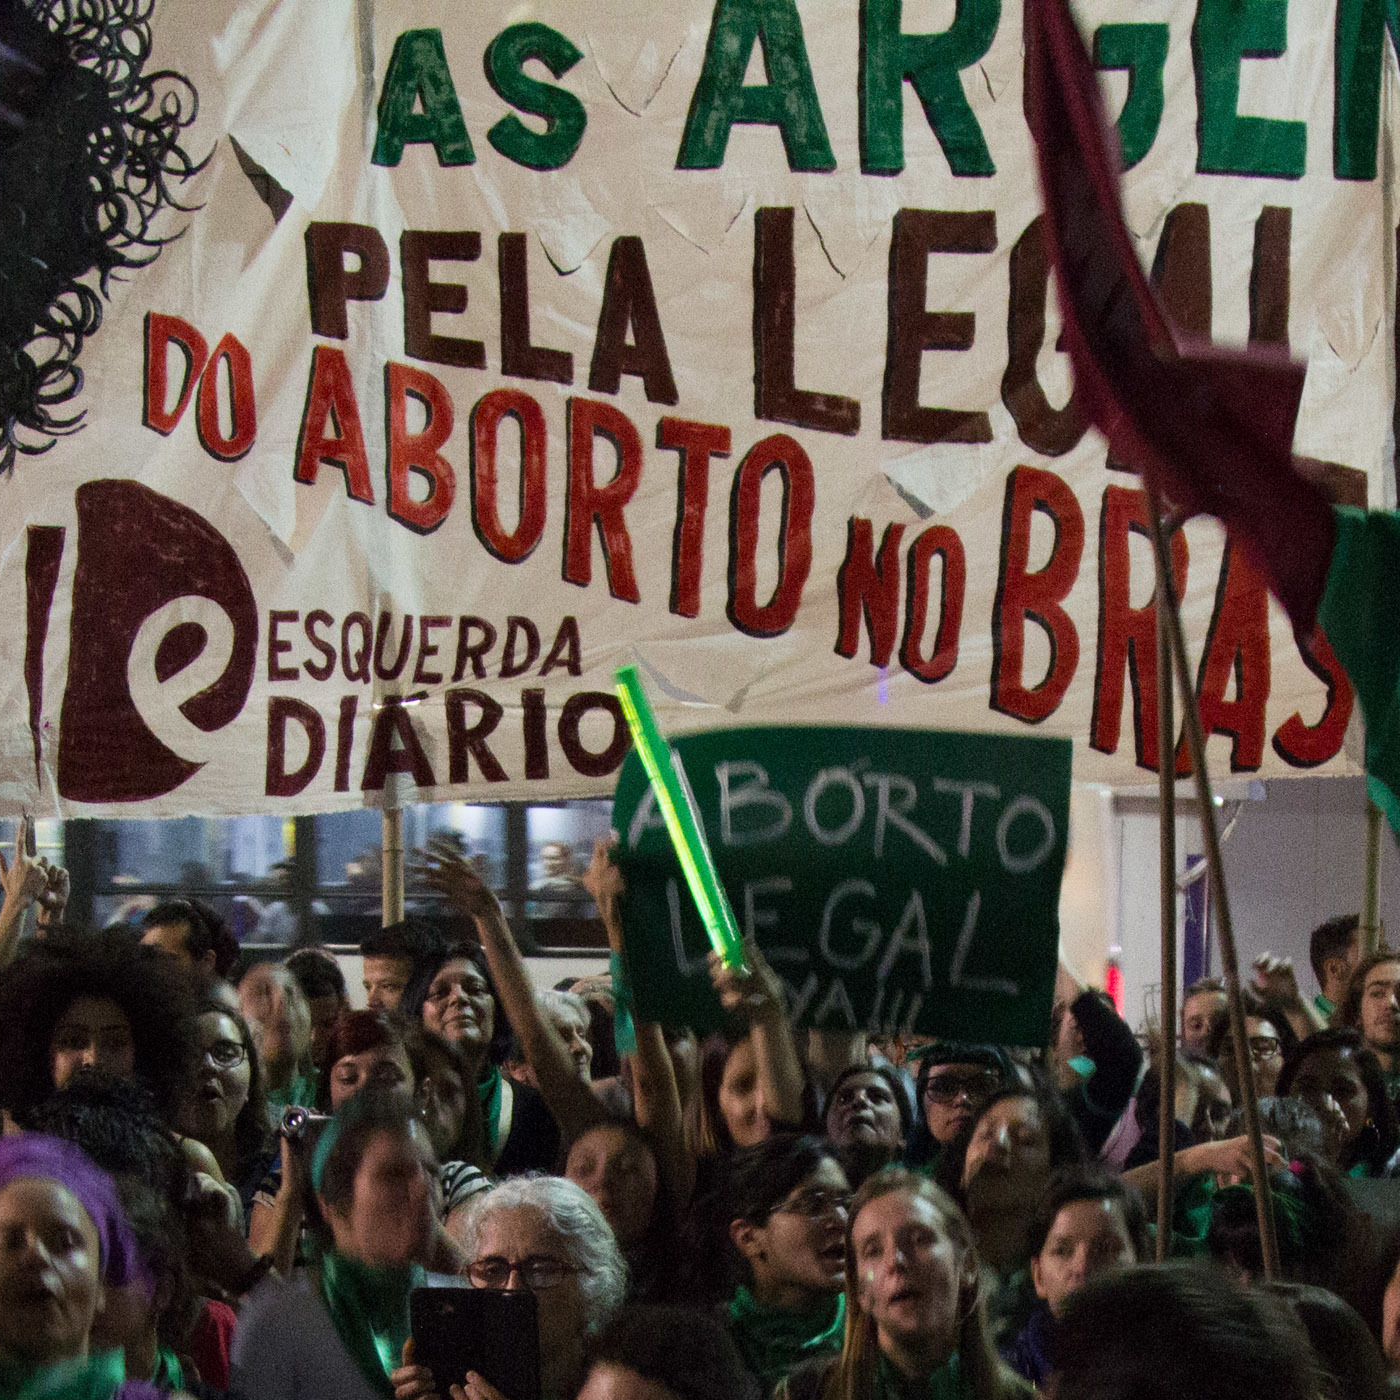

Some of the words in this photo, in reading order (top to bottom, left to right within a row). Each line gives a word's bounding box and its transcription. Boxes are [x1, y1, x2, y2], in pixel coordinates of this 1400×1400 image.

[372, 22, 588, 171] AS
[303, 221, 679, 406] PELA
[143, 311, 257, 463] DO
[294, 345, 814, 638] ABORTO
[834, 516, 966, 683] NO
[268, 609, 582, 685] ESQUERDA
[627, 757, 1057, 873] ABORTO
[665, 877, 1019, 997] LEGAL
